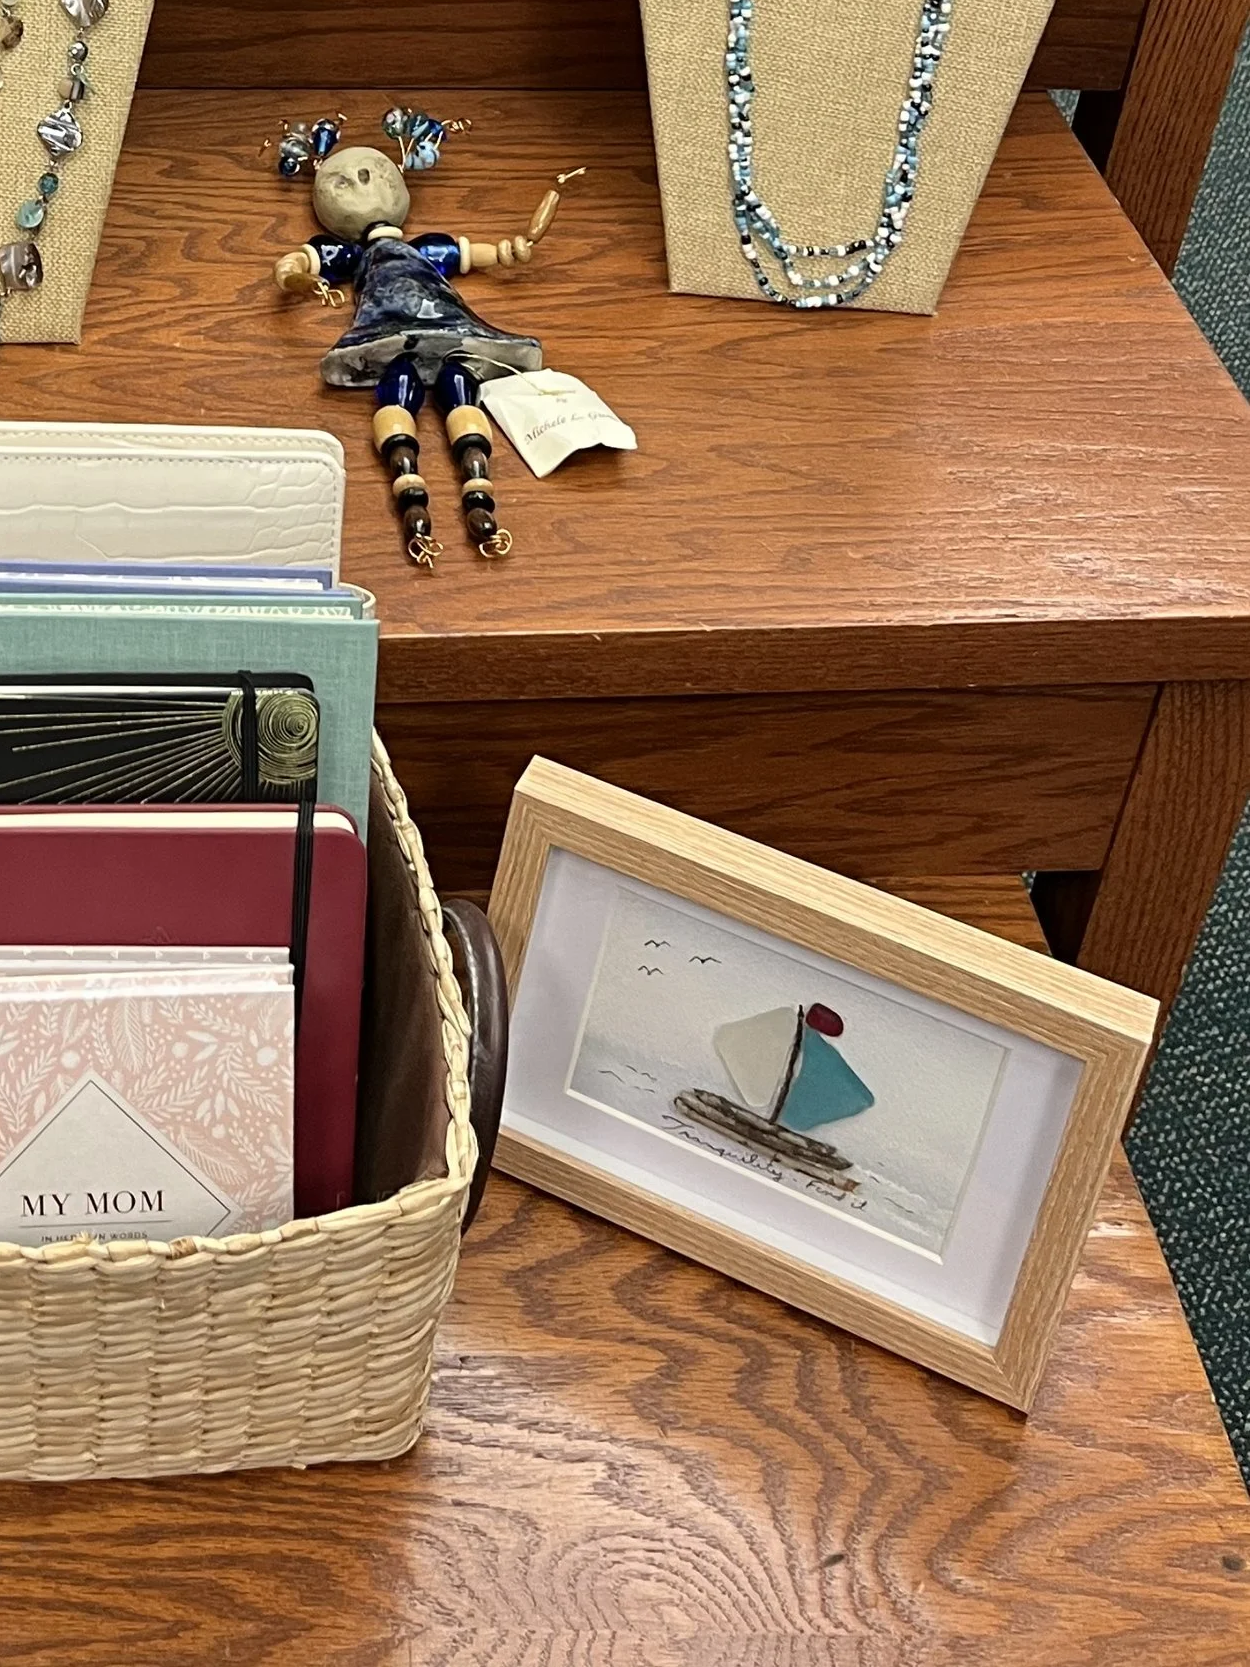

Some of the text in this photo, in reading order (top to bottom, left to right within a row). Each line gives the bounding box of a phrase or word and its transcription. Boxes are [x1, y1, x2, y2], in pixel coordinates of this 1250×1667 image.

[19, 1188, 167, 1218] MY MOM
[805, 1180, 847, 1202] Find
[850, 1200, 868, 1210] it
[109, 1230, 149, 1240] WORDS
